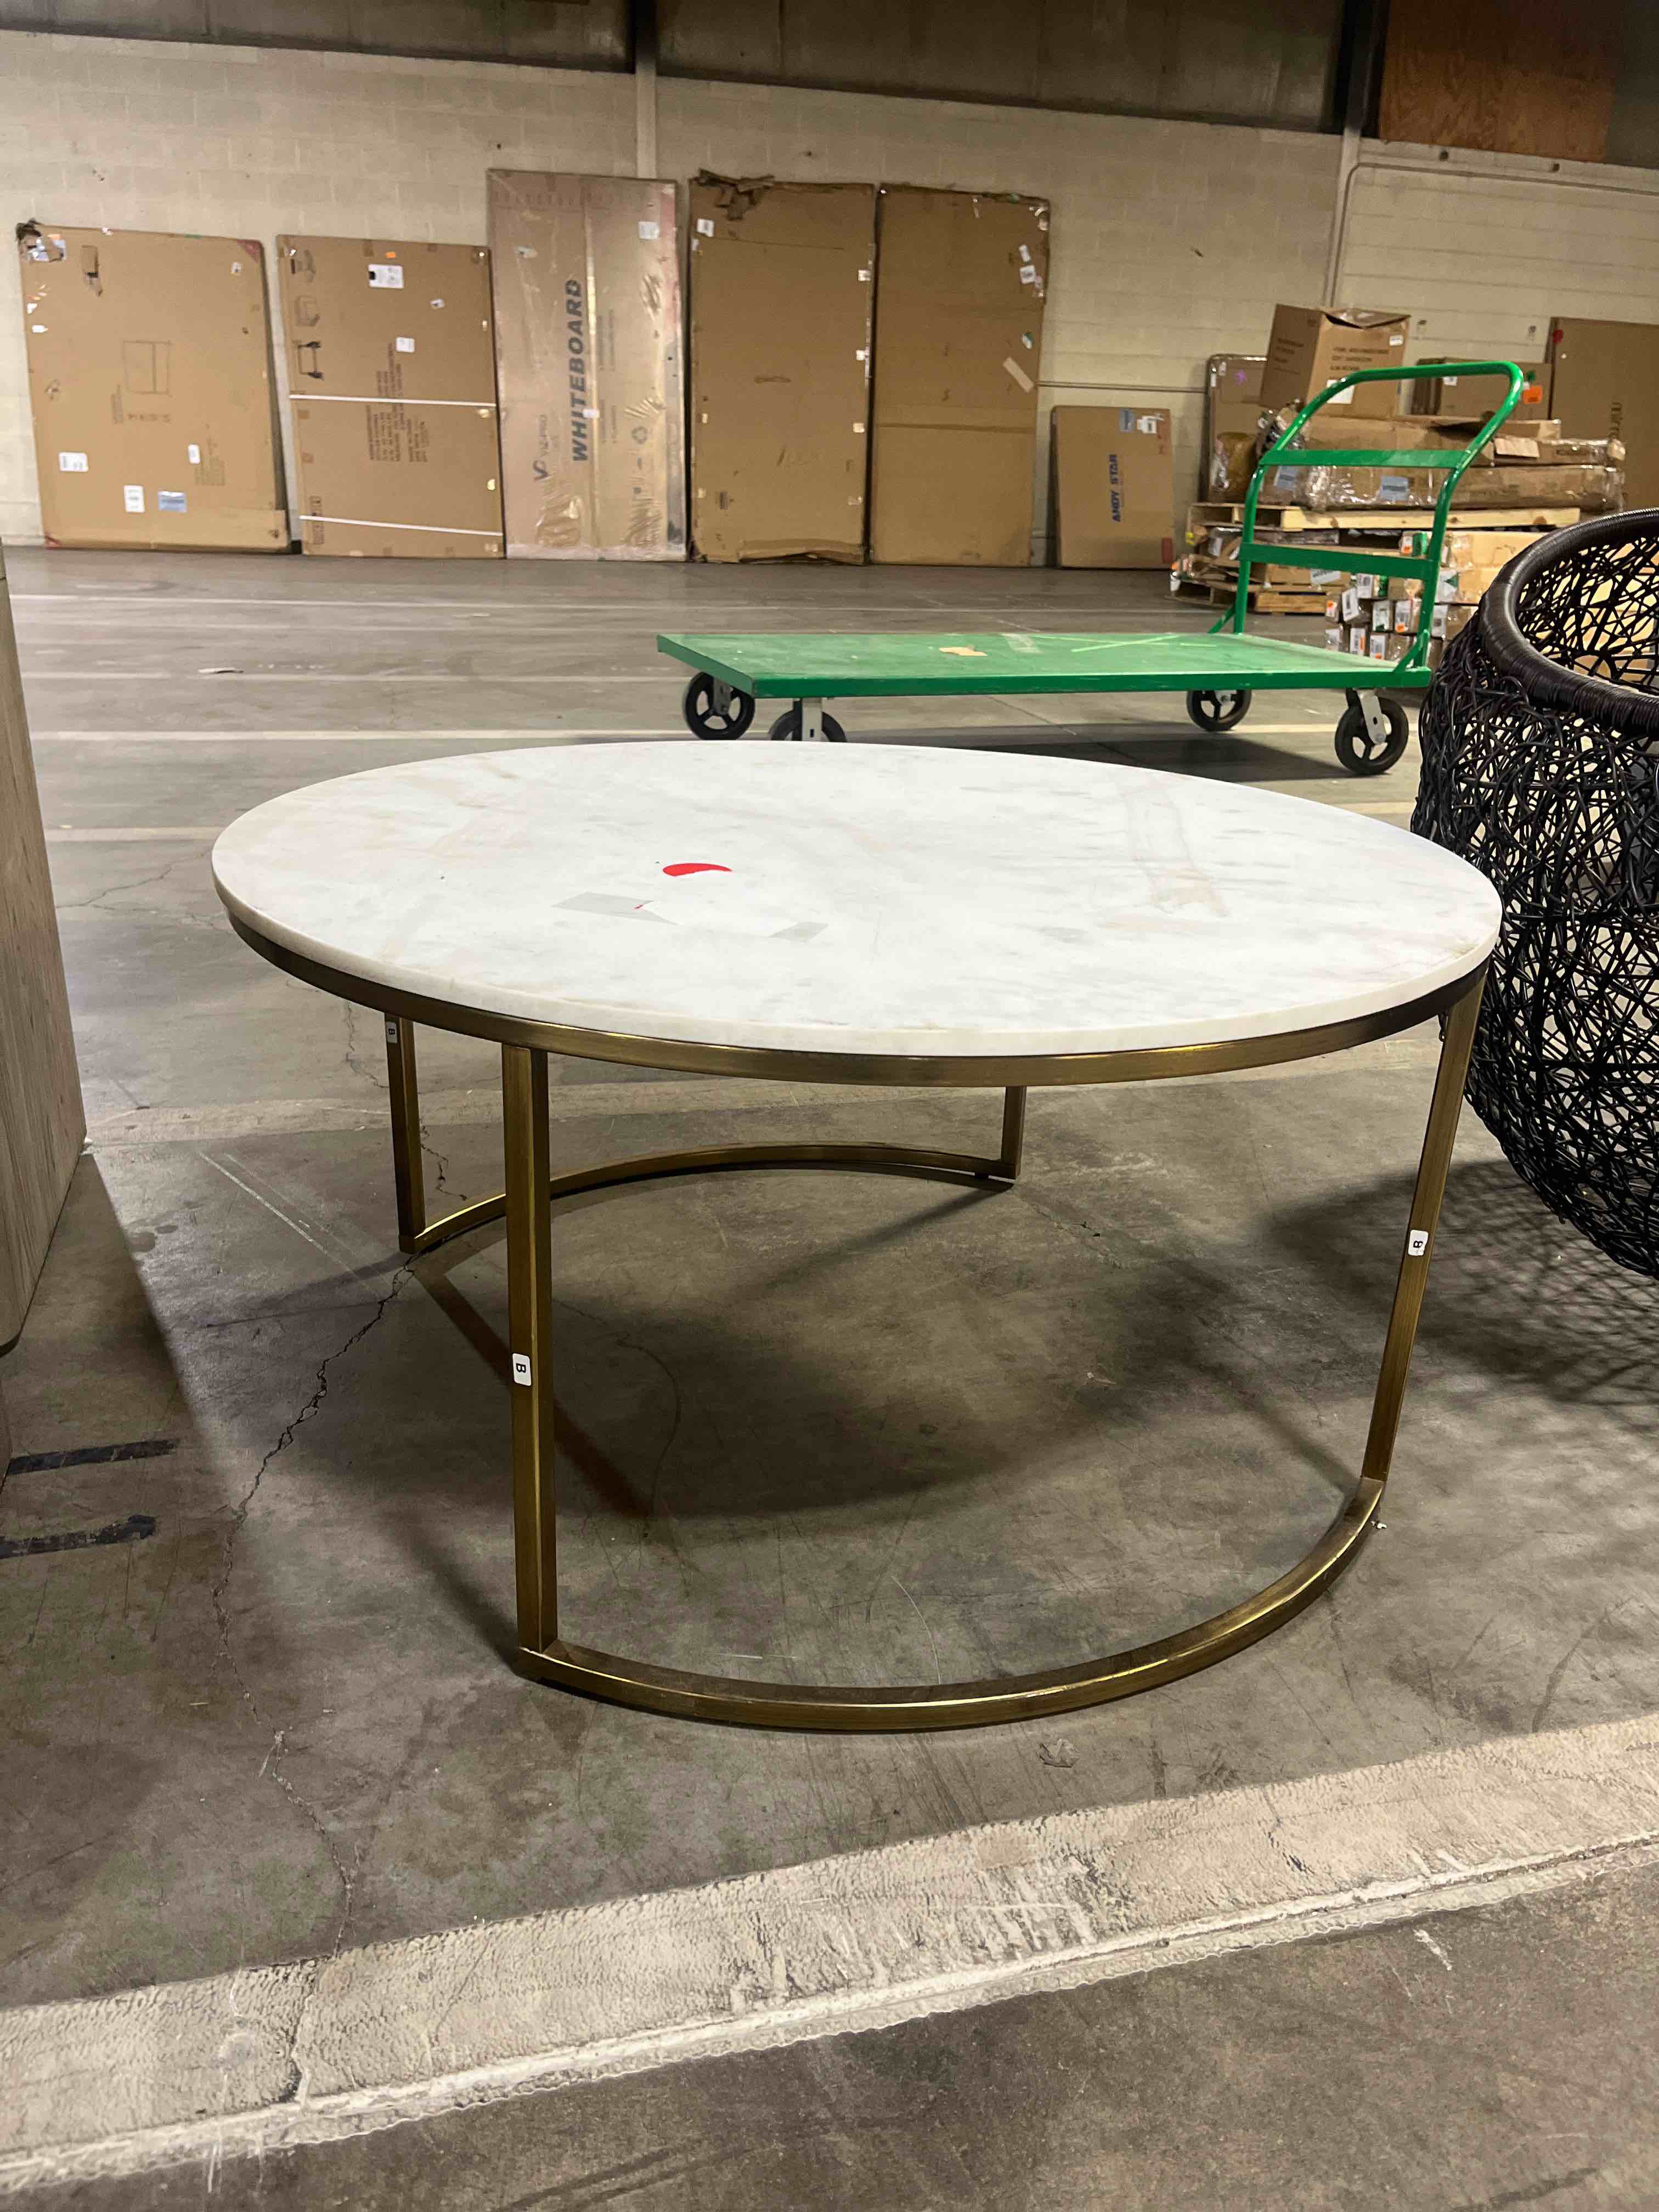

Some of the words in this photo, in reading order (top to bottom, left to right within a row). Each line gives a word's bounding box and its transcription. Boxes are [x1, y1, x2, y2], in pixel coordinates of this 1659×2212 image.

[565, 280, 588, 461] WHITEBOARD
[1413, 1240, 1424, 1248] B
[516, 1363, 527, 1373] B
